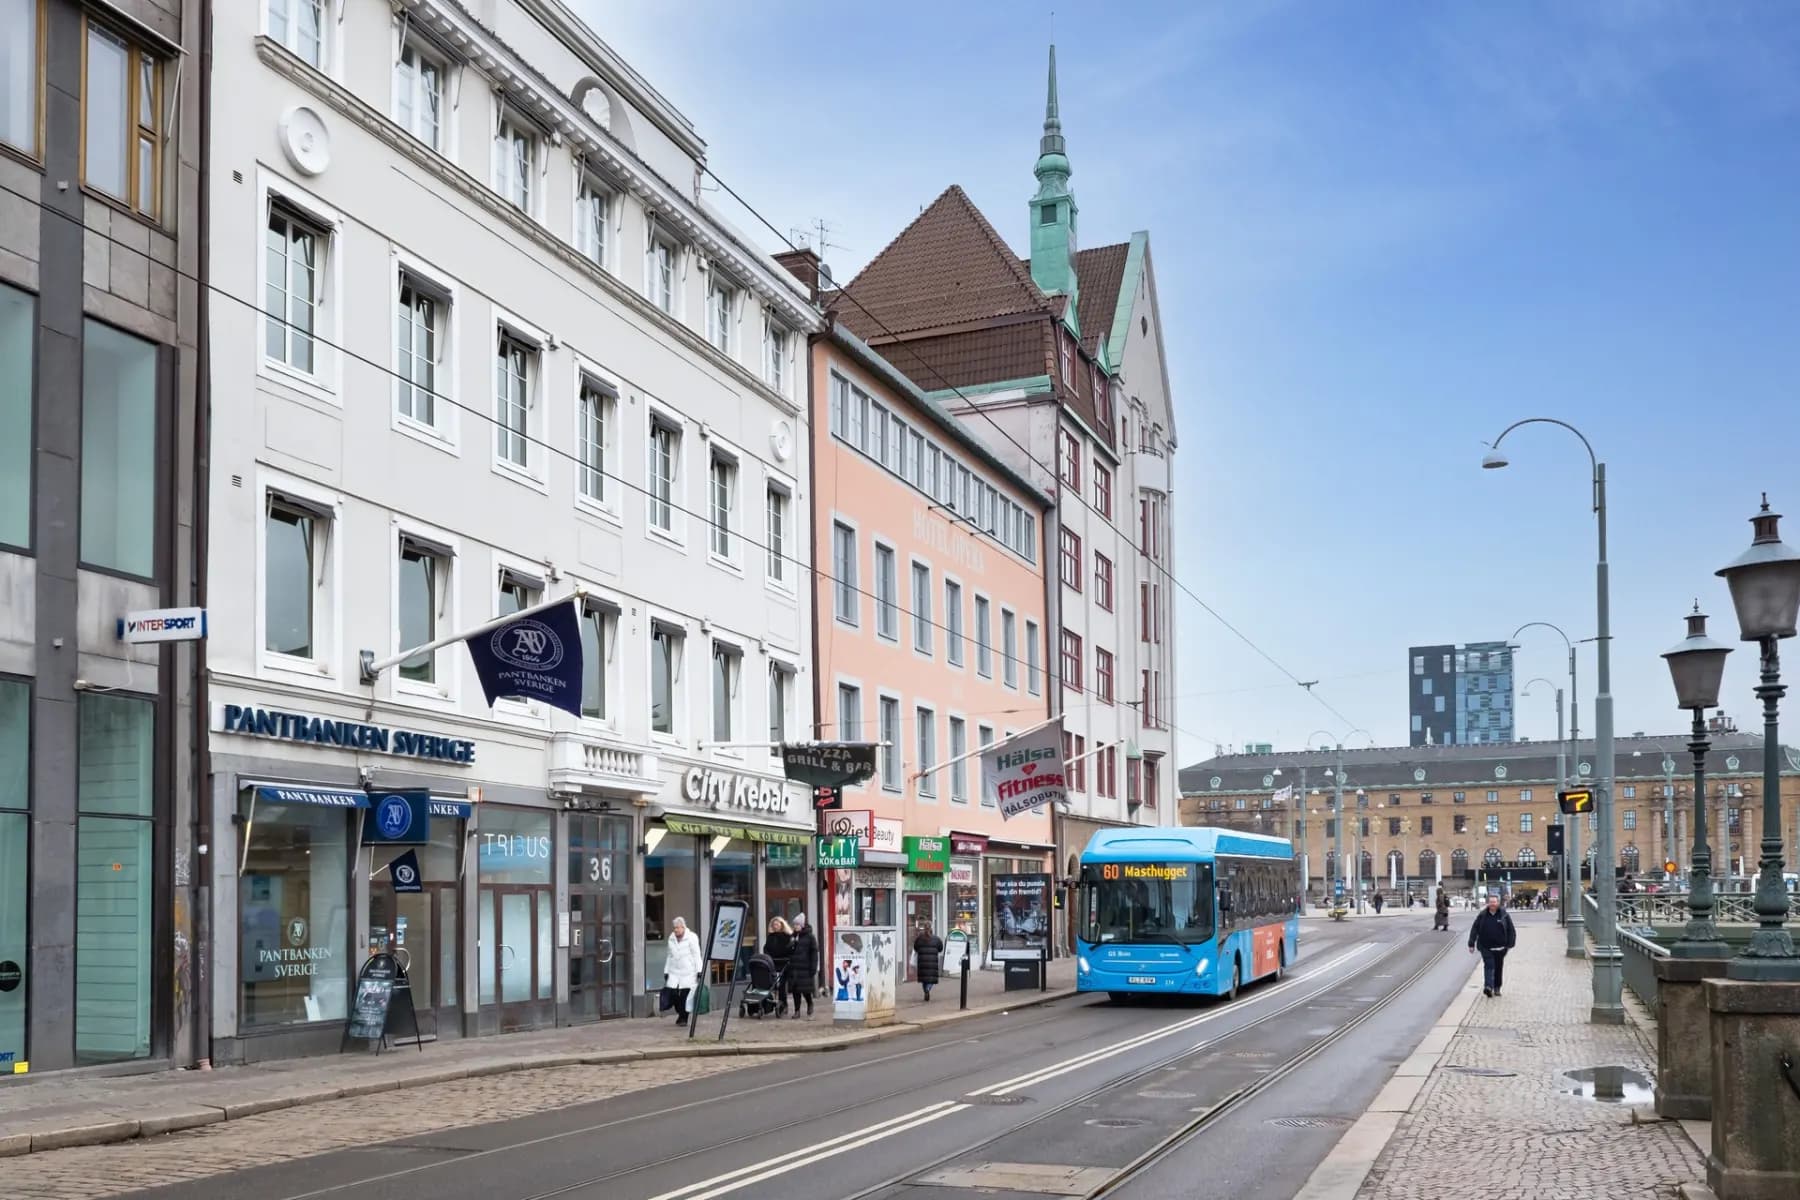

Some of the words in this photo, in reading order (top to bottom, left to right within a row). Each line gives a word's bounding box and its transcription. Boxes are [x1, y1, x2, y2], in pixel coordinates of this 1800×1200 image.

[136, 616, 196, 633] INTERSPORT
[498, 670, 567, 688] PANTBANKEN
[513, 678, 555, 693] SVERIGE
[224, 704, 389, 751] PANTBANKEN
[392, 730, 476, 763] SVERIGE
[787, 754, 828, 769] GRILL
[831, 761, 841, 772] &
[845, 761, 872, 774] BAR
[997, 747, 1056, 771] Hälsa
[682, 766, 731, 810] City
[733, 774, 793, 814] Kebab
[998, 774, 1065, 802] Fitness
[278, 790, 356, 806] PANTBANKEN
[818, 838, 857, 857] CITY
[590, 857, 611, 881] 36
[841, 857, 856, 866] BAR
[1103, 864, 1120, 880] 60
[1124, 864, 1188, 880] Masthugget
[259, 947, 333, 963] PANTBANKEN
[274, 962, 319, 978] SVERIGE
